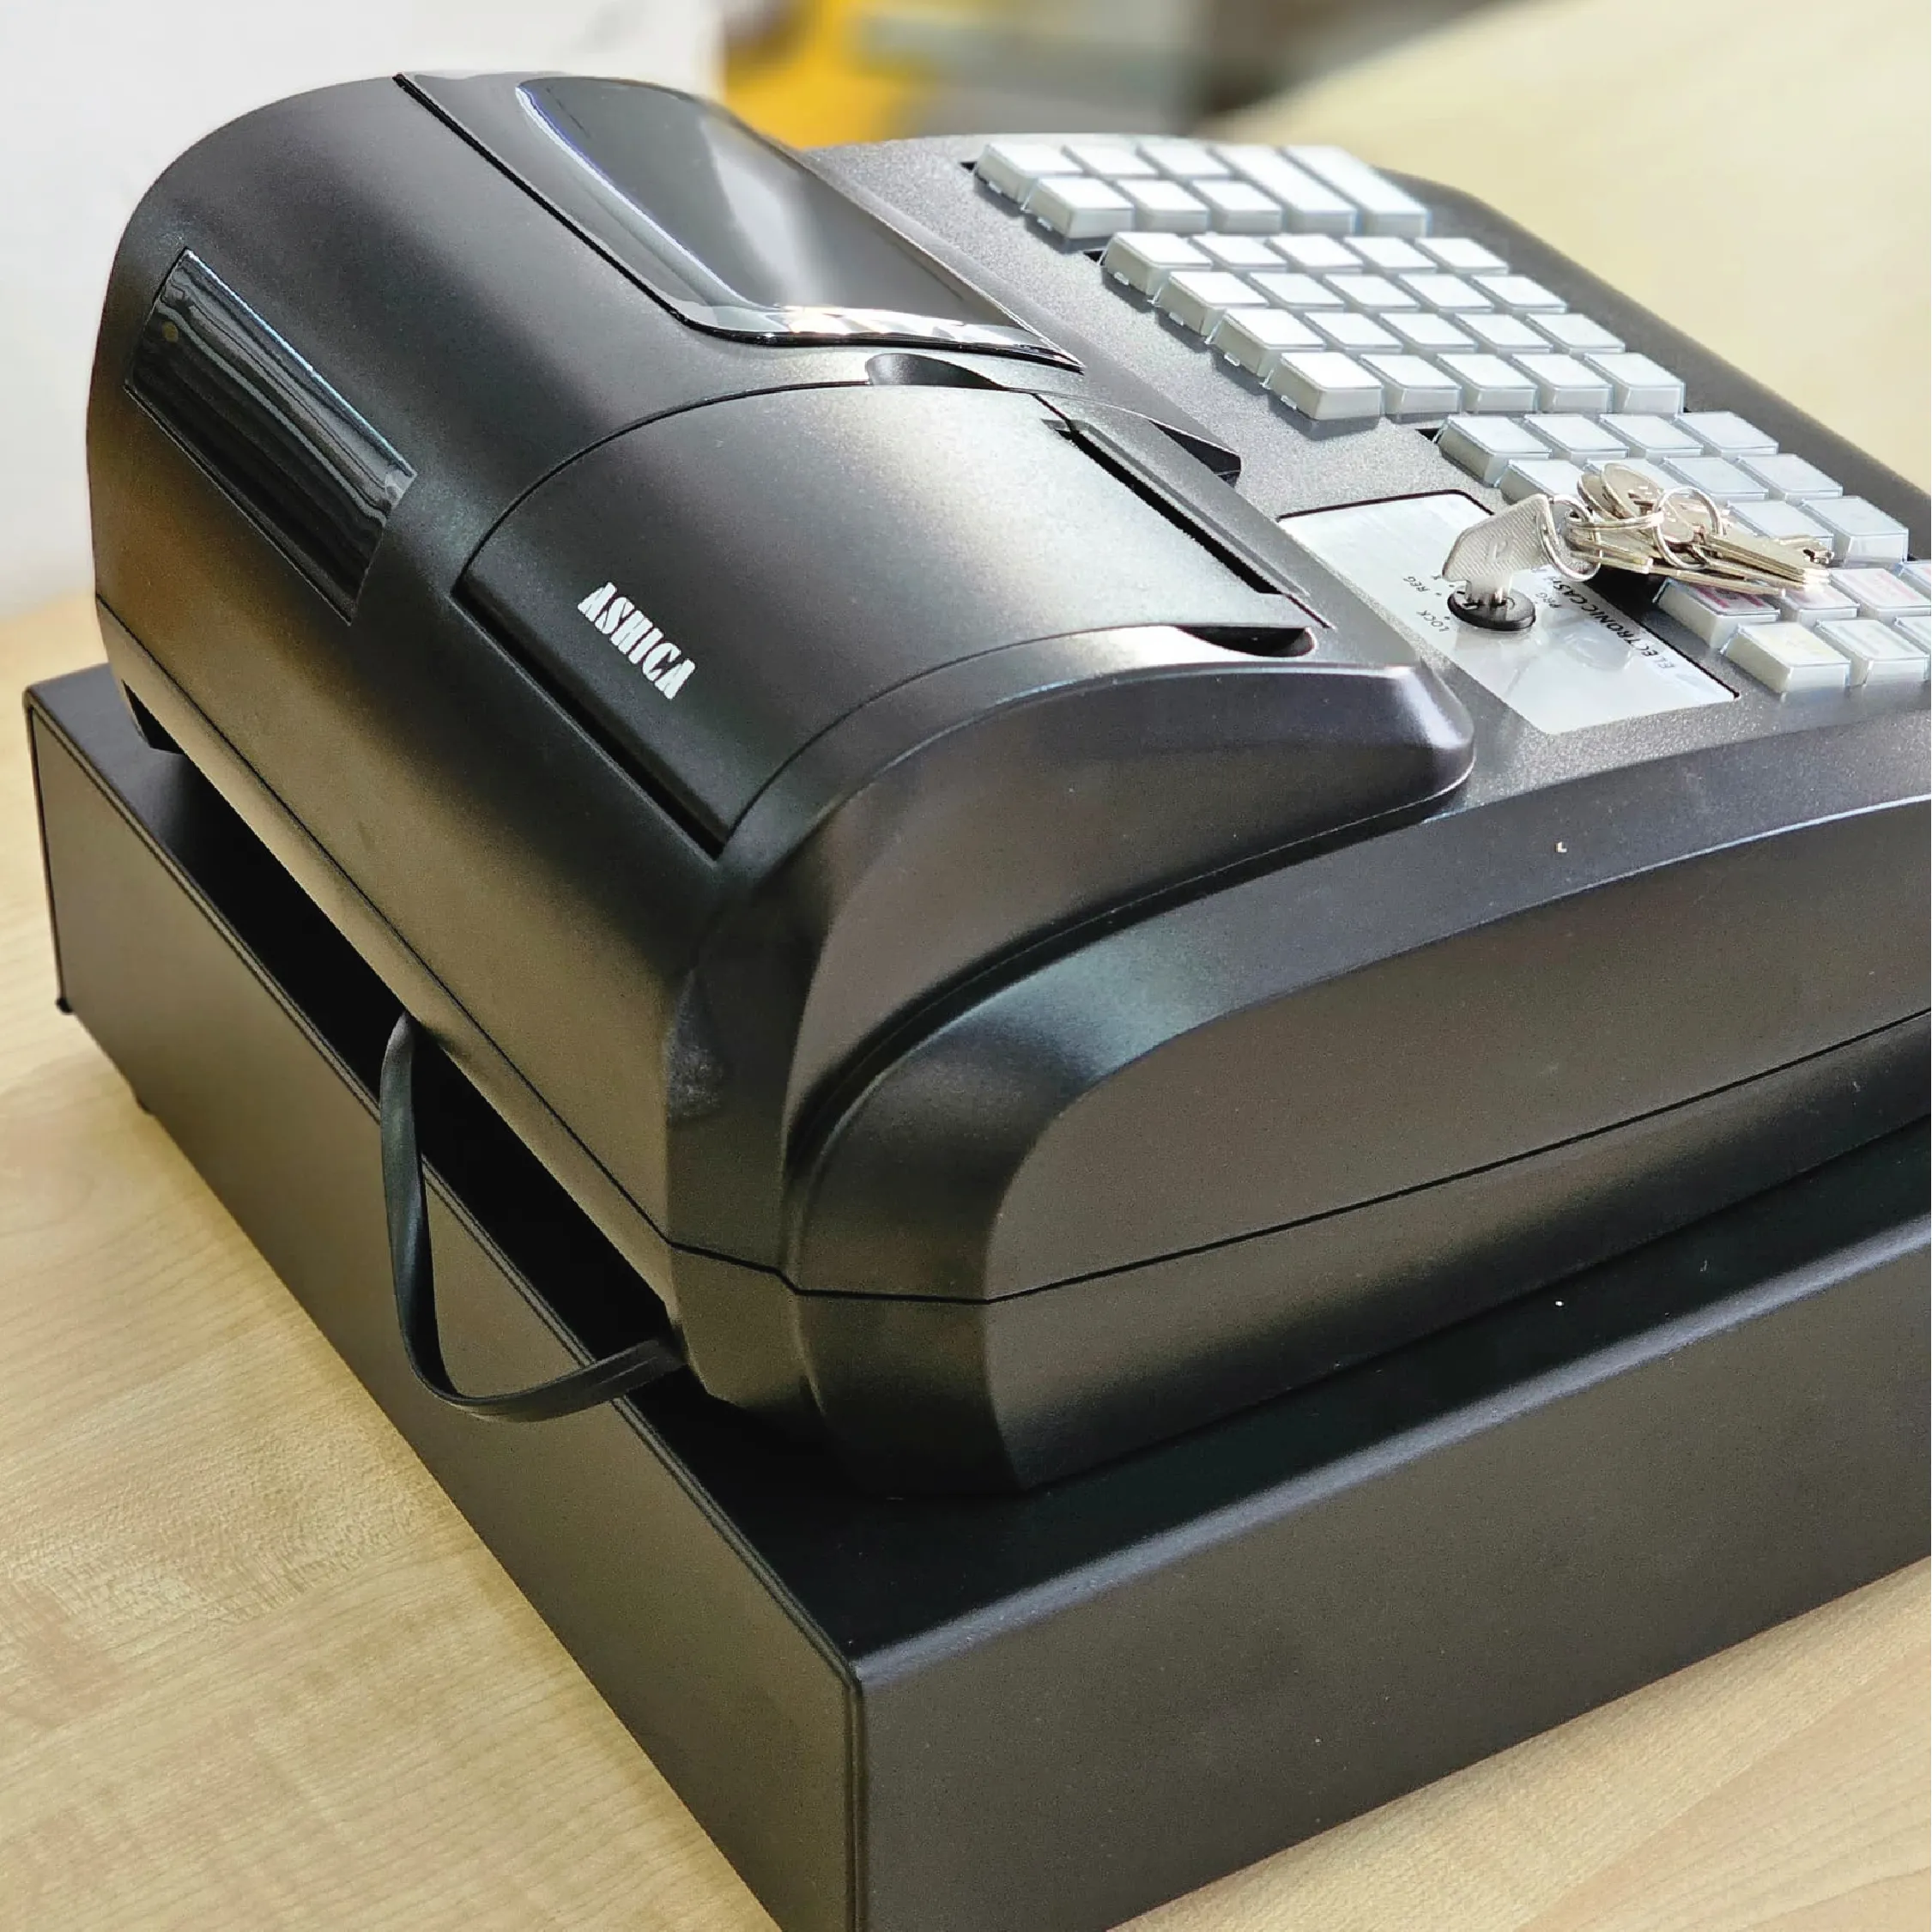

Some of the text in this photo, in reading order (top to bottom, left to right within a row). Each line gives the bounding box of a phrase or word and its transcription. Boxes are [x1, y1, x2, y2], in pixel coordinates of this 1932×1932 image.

[1402, 576, 1431, 592] REG
[1535, 592, 1561, 609] PRG
[1416, 610, 1451, 632] LOCK
[578, 582, 696, 700] ASHICA
[1581, 603, 1675, 669] ELECTRONIC
